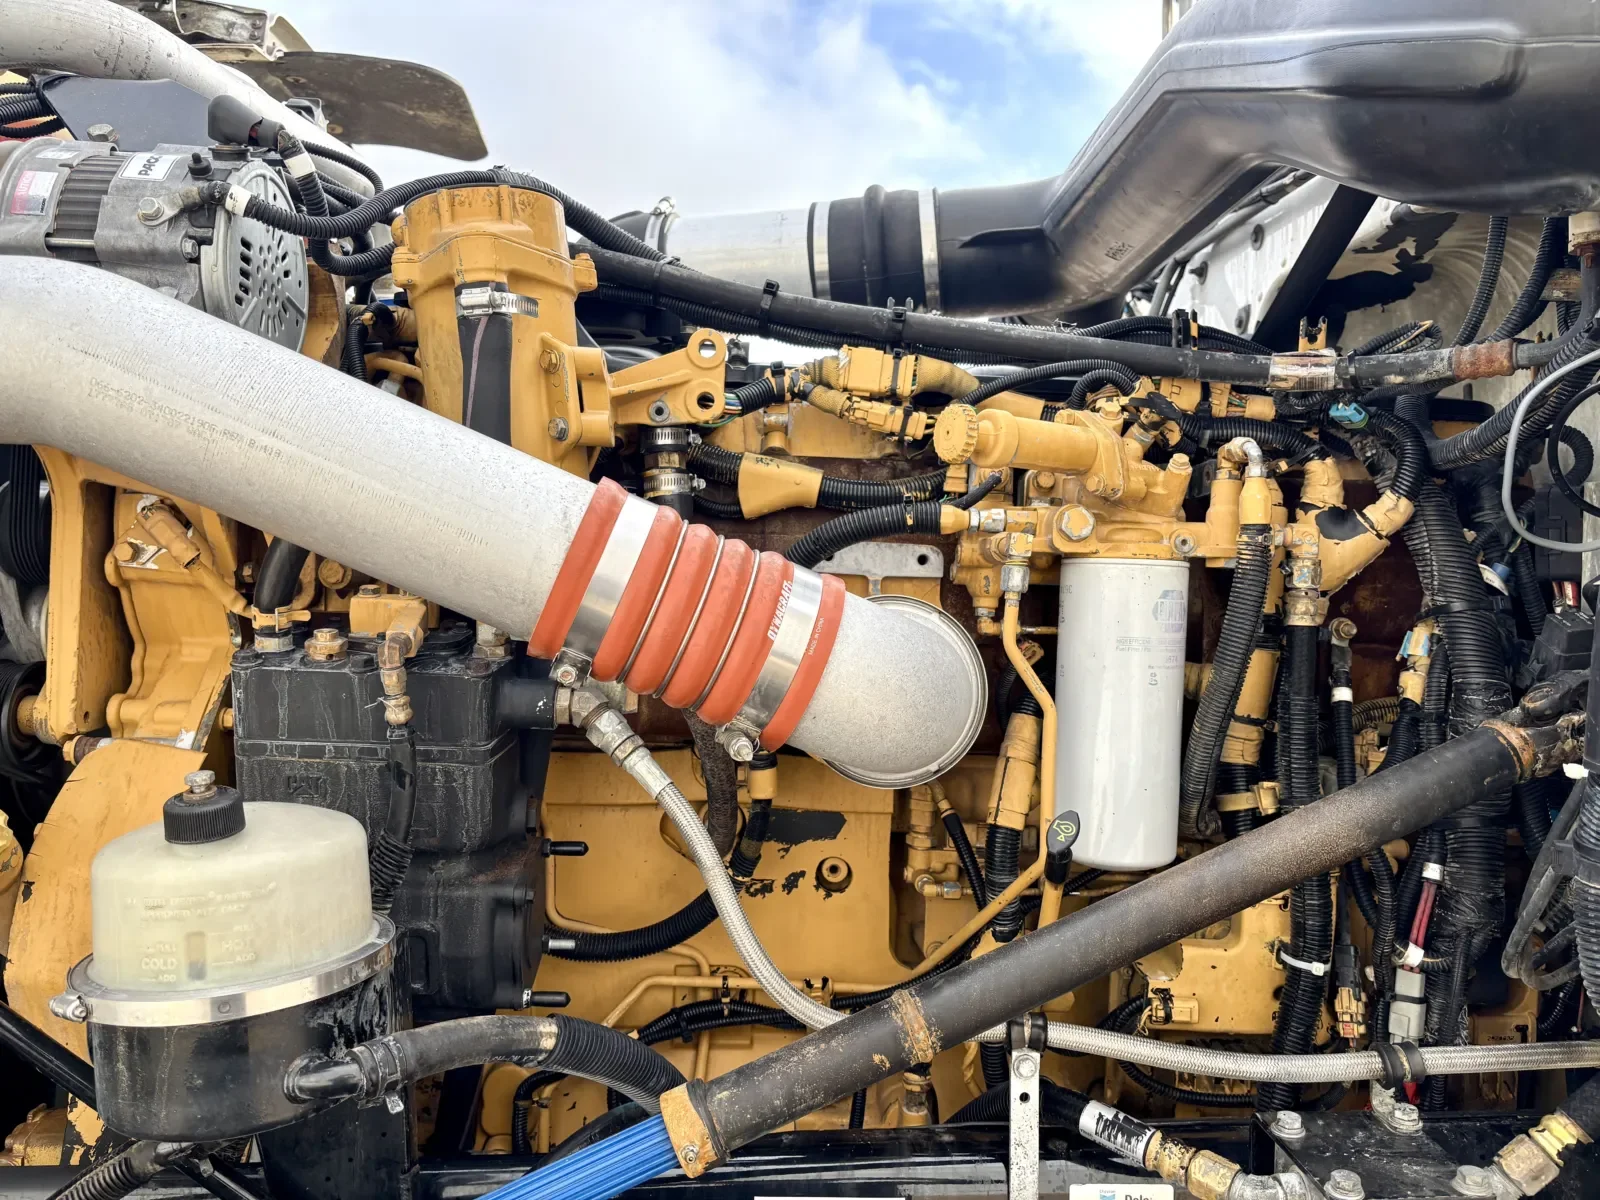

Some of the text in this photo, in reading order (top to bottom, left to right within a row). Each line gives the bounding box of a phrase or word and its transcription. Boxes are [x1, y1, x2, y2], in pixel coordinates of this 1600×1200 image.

[808, 639, 818, 656] MADE
[815, 617, 825, 633] CHINA
[285, 774, 321, 799] CAT
[221, 937, 253, 953] HOT
[141, 957, 177, 970] COLD
[235, 952, 256, 963] ADD
[158, 974, 176, 982] ADD
